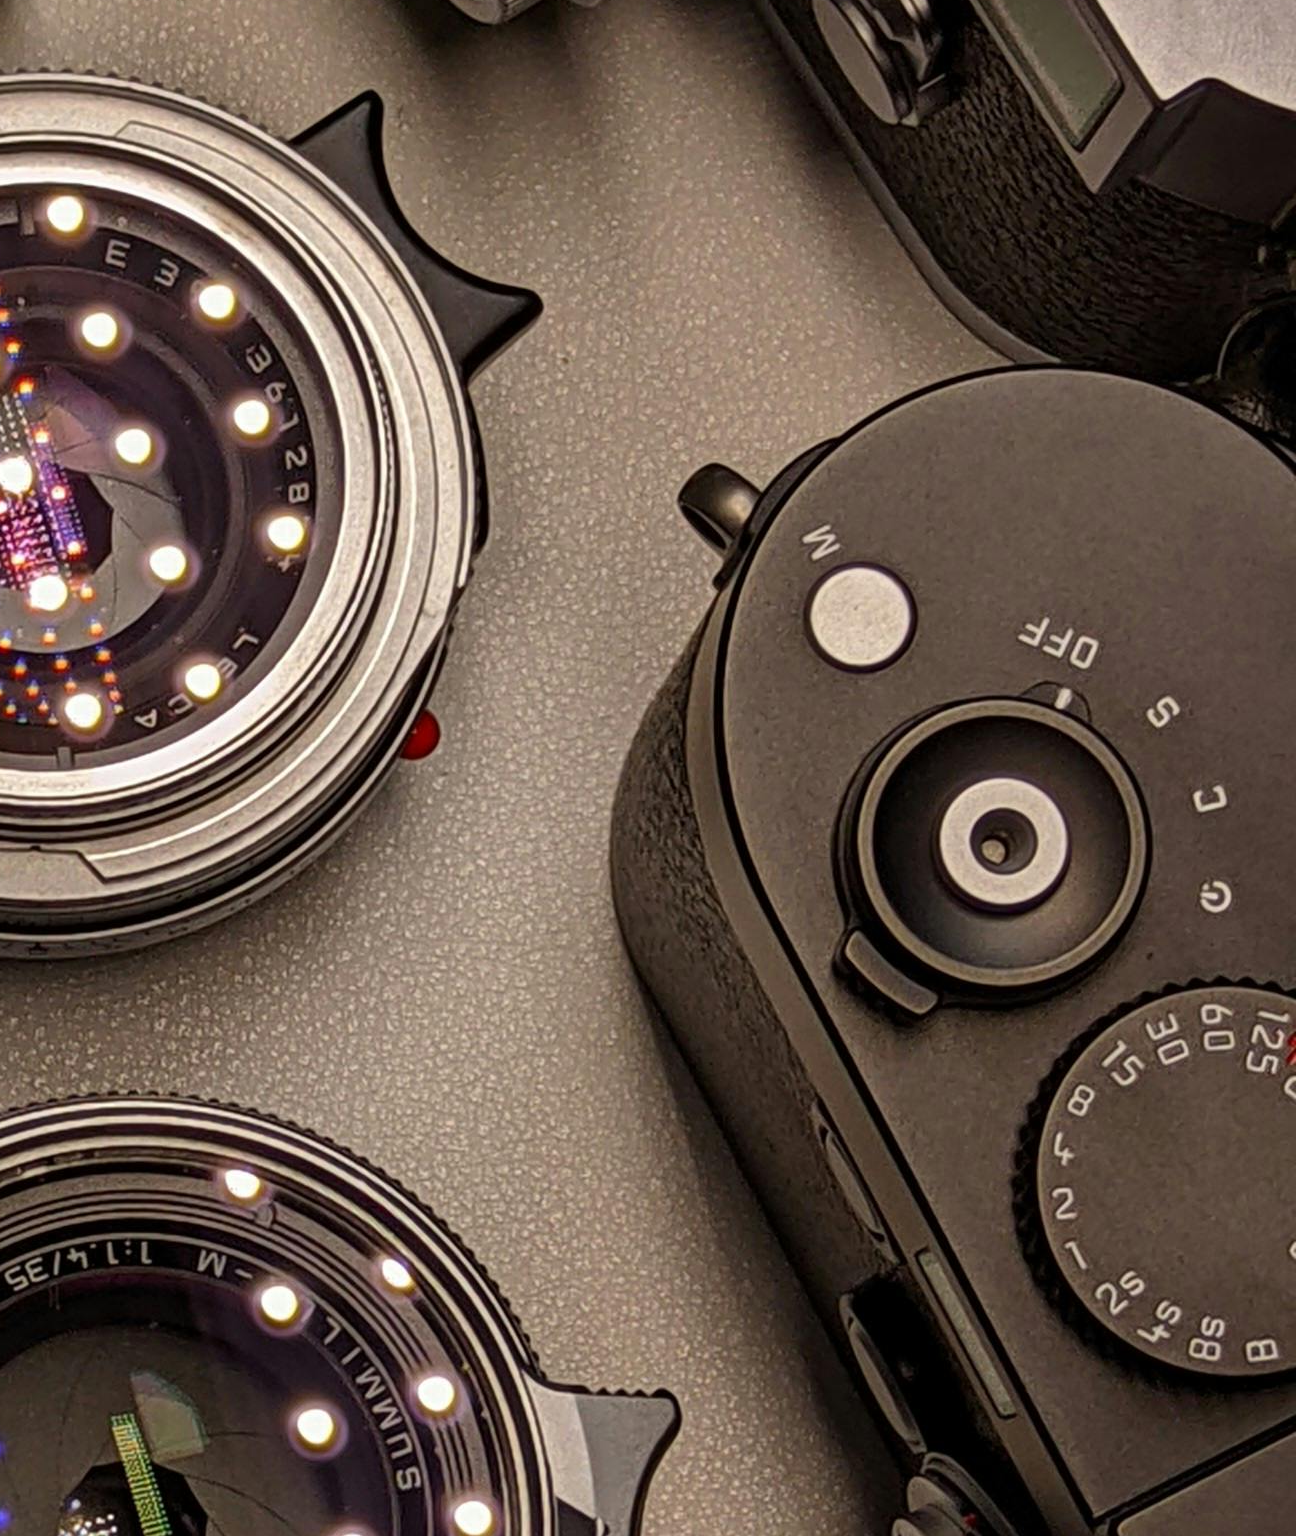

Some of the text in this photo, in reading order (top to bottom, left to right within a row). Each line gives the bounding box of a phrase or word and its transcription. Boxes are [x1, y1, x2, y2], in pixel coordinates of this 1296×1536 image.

[133, 342, 311, 729] 361284 LECA
[800, 524, 842, 563] M
[1017, 615, 1101, 672] OFF
[1145, 693, 1181, 731] S
[1192, 783, 1229, 814] C
[1146, 1011, 1191, 1066] 30
[1201, 1002, 1237, 1052] 60
[1246, 1009, 1292, 1076] 125
[1100, 1038, 1145, 1087] 15
[1066, 1083, 1096, 1118] 8
[1052, 1130, 1076, 1166] 4
[1051, 1186, 1078, 1221] 2
[1064, 1240, 1089, 1271] 1
[1244, 1336, 1281, 1364] B
[196, 1249, 422, 1492] SUMMIL-M
